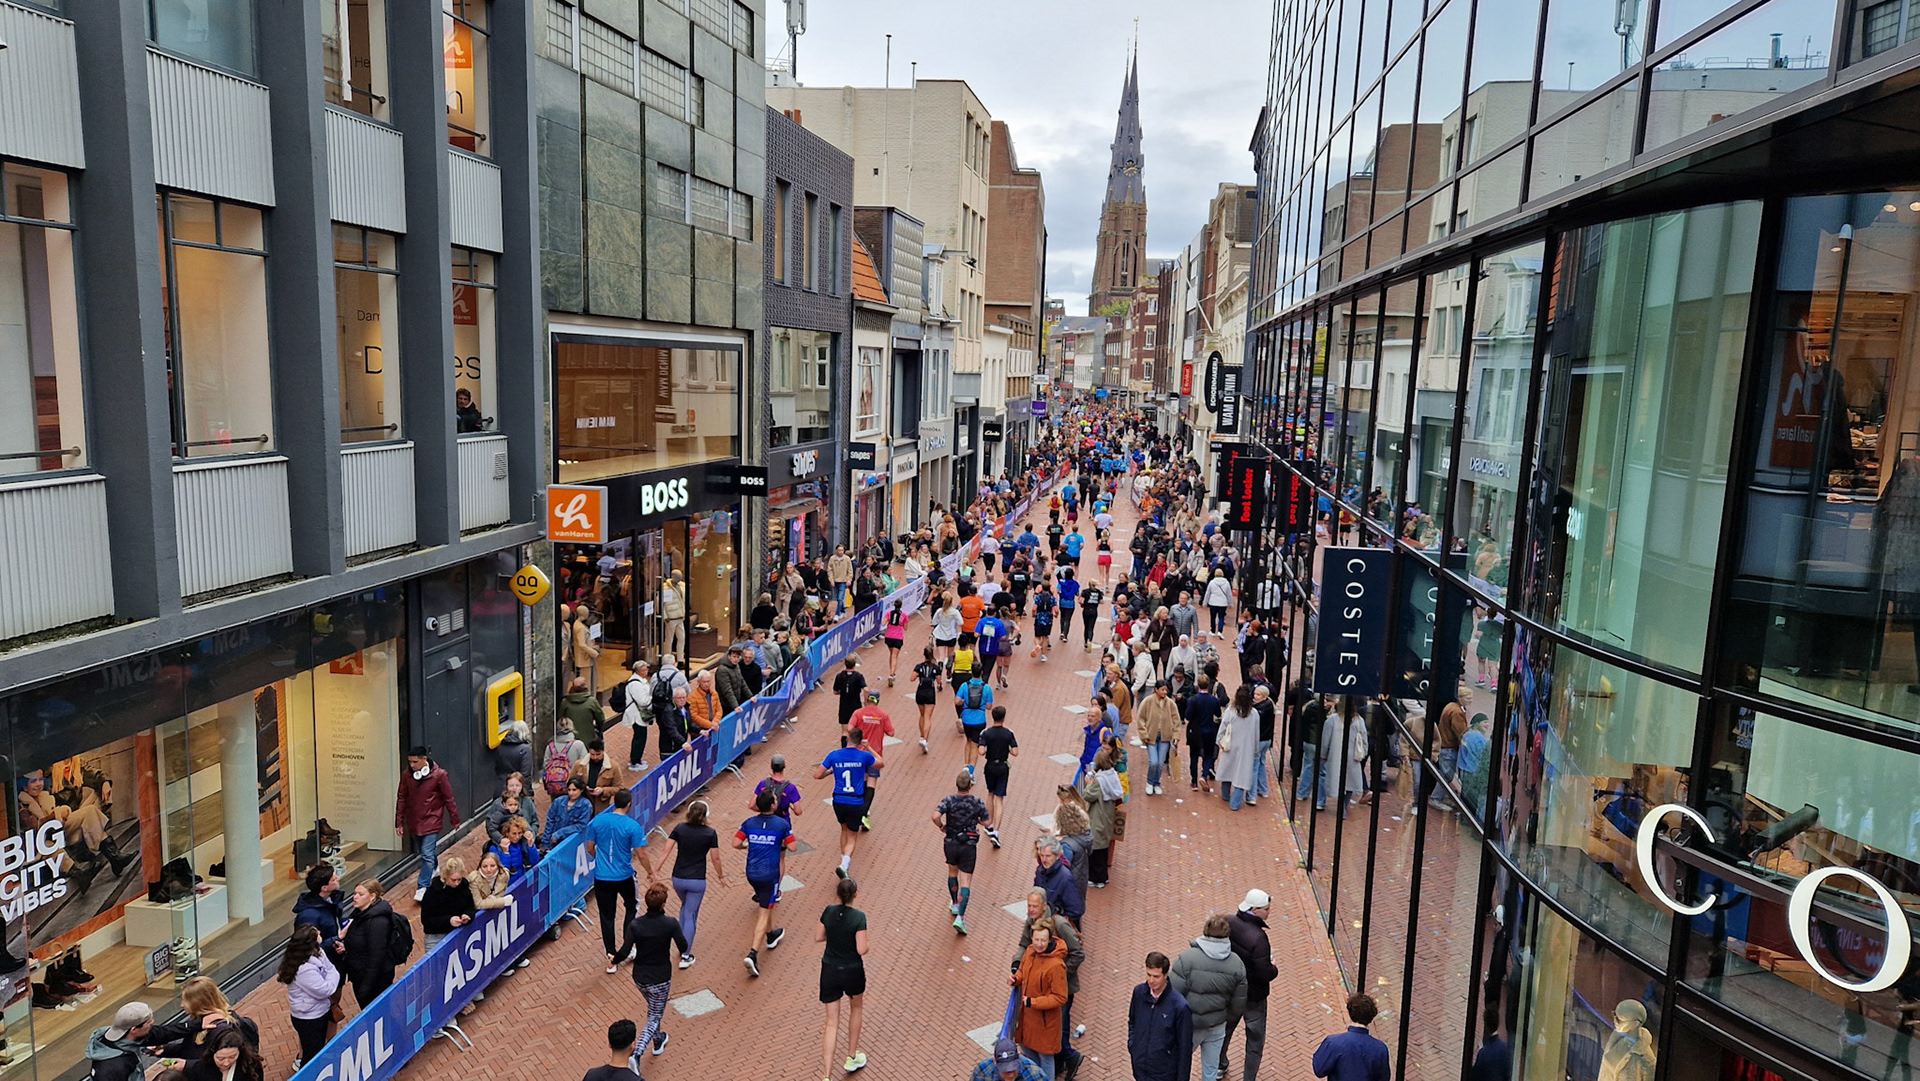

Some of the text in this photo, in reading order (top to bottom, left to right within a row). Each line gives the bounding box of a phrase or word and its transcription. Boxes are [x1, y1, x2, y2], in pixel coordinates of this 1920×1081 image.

[1222, 374, 1236, 426] WAM DENIM
[641, 477, 689, 516] BOSS
[740, 476, 765, 486] BOSS
[1240, 468, 1254, 522] Foot Locker
[554, 531, 595, 539] vanHaren
[853, 610, 876, 641] ASML
[1338, 559, 1366, 686] COSTES
[820, 632, 843, 668] ASML
[655, 749, 702, 812] ASML
[842, 770, 855, 792] 1
[0, 819, 66, 875] BIG
[0, 852, 65, 901] CITY
[0, 878, 68, 923] VIBES
[154, 947, 169, 962] BIG
[444, 900, 525, 1004] ASML
